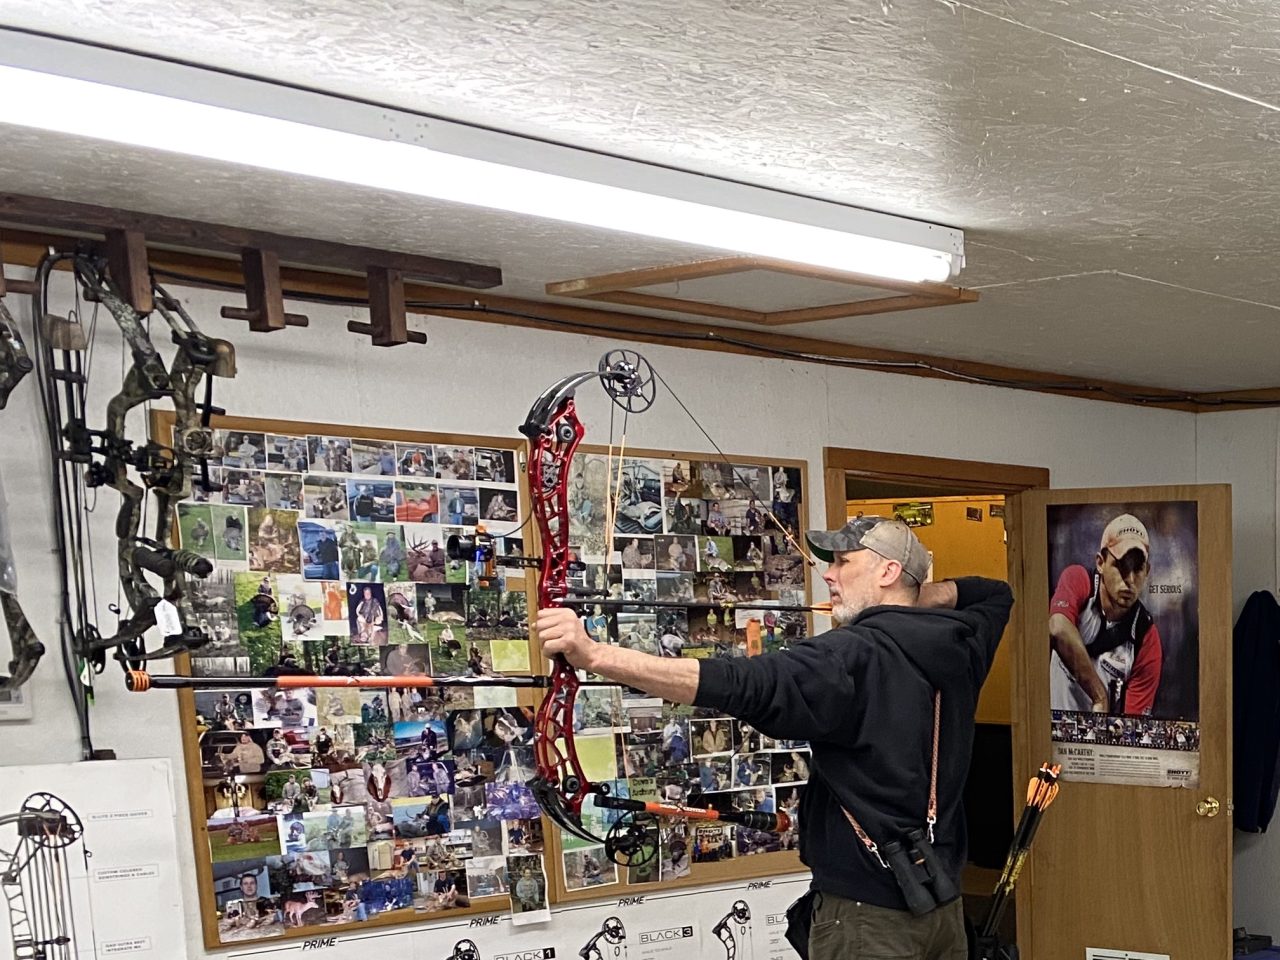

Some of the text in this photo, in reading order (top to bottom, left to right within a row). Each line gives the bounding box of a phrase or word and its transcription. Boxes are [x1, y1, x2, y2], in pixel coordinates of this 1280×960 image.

[747, 880, 772, 890] PRIME
[617, 896, 646, 906] PRIME
[469, 915, 500, 927] PRIME
[768, 915, 788, 924] BLA
[641, 928, 681, 943] BLACK
[302, 937, 337, 950] PRIME
